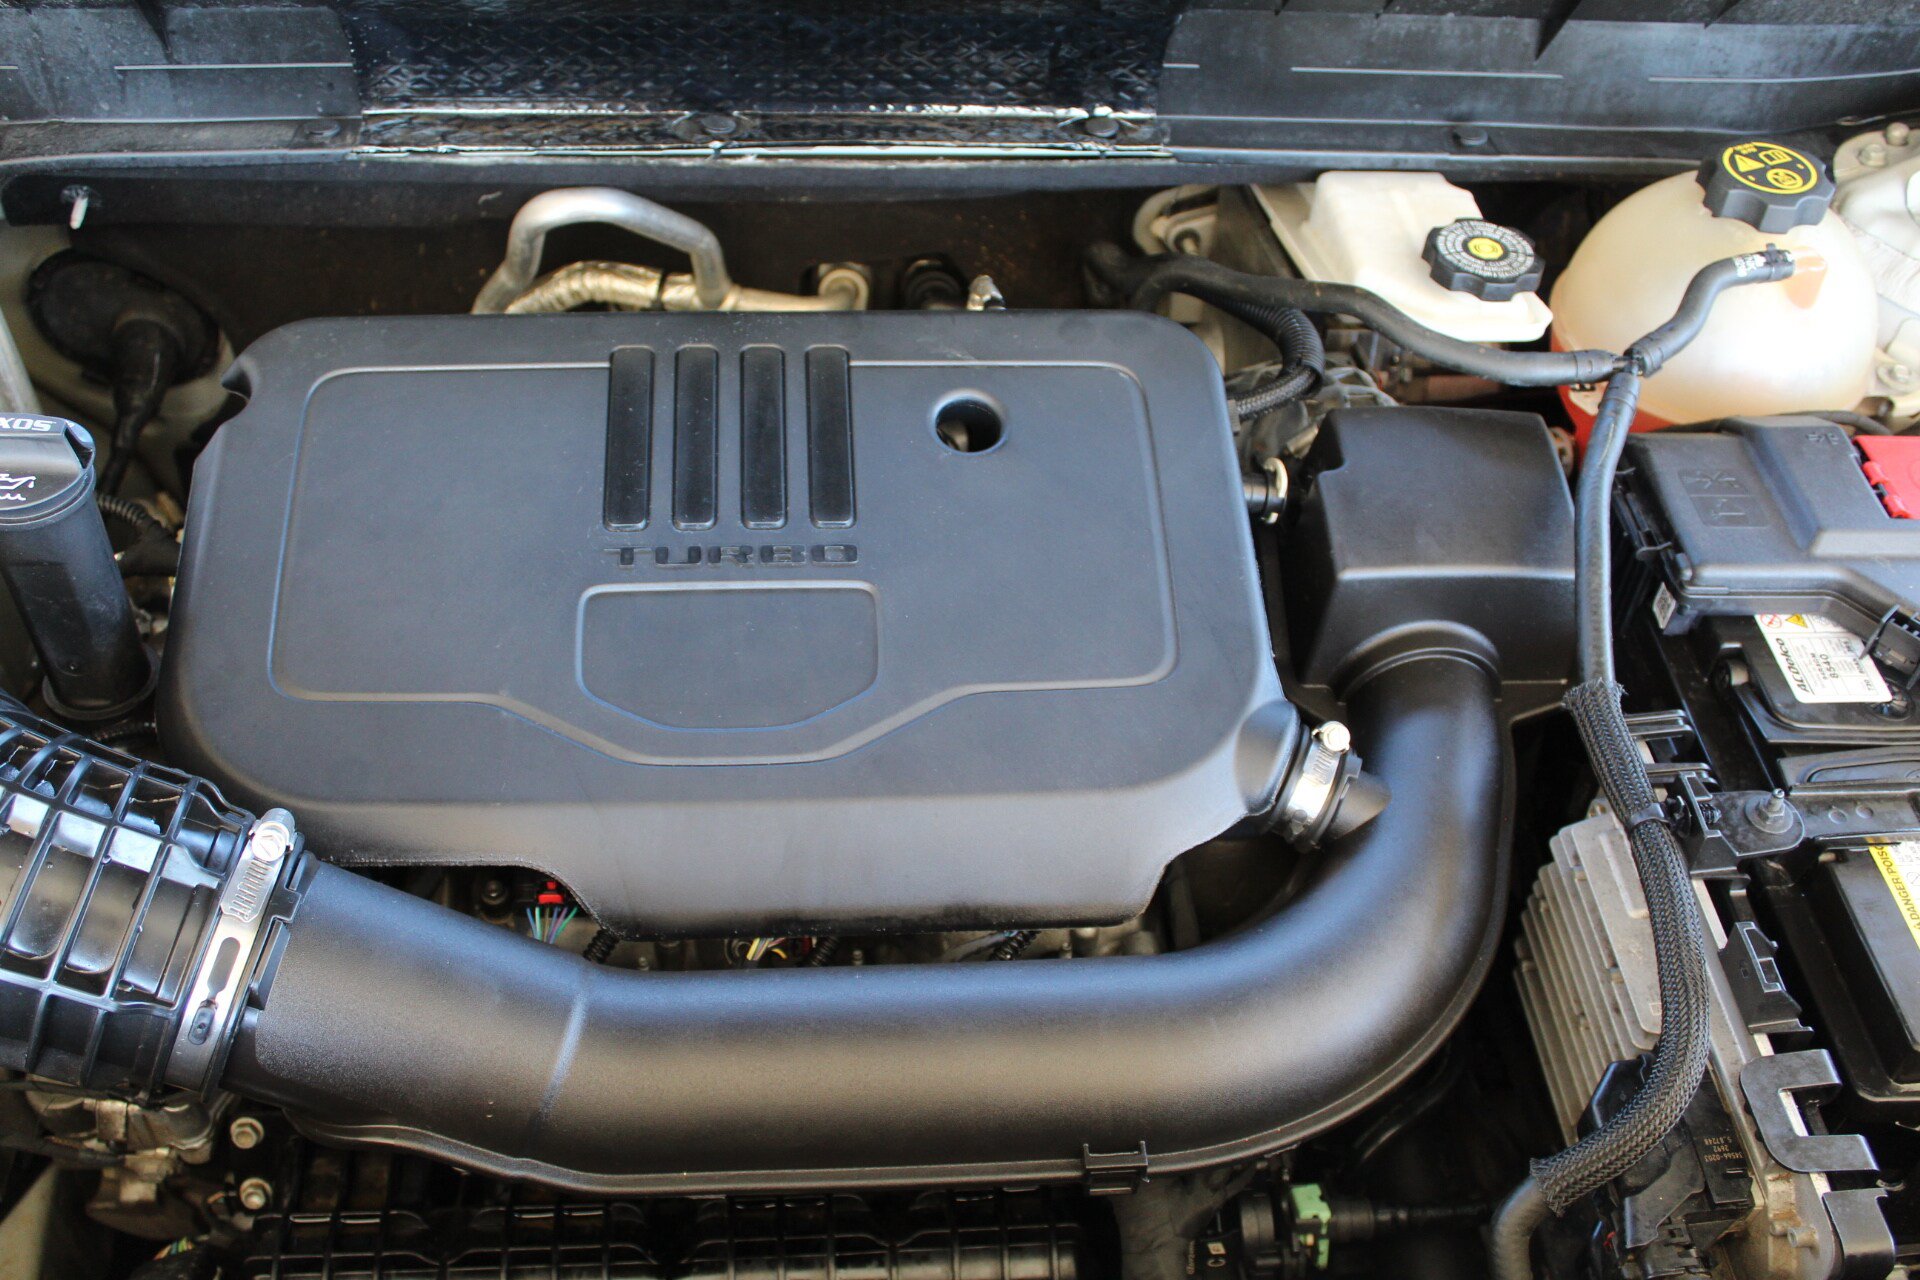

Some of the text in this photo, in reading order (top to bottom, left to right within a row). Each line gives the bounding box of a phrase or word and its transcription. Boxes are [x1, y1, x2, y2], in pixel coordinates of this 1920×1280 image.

[603, 544, 859, 569] TURBO
[1775, 637, 1810, 693] ACDelco
[1819, 653, 1840, 680] 8540
